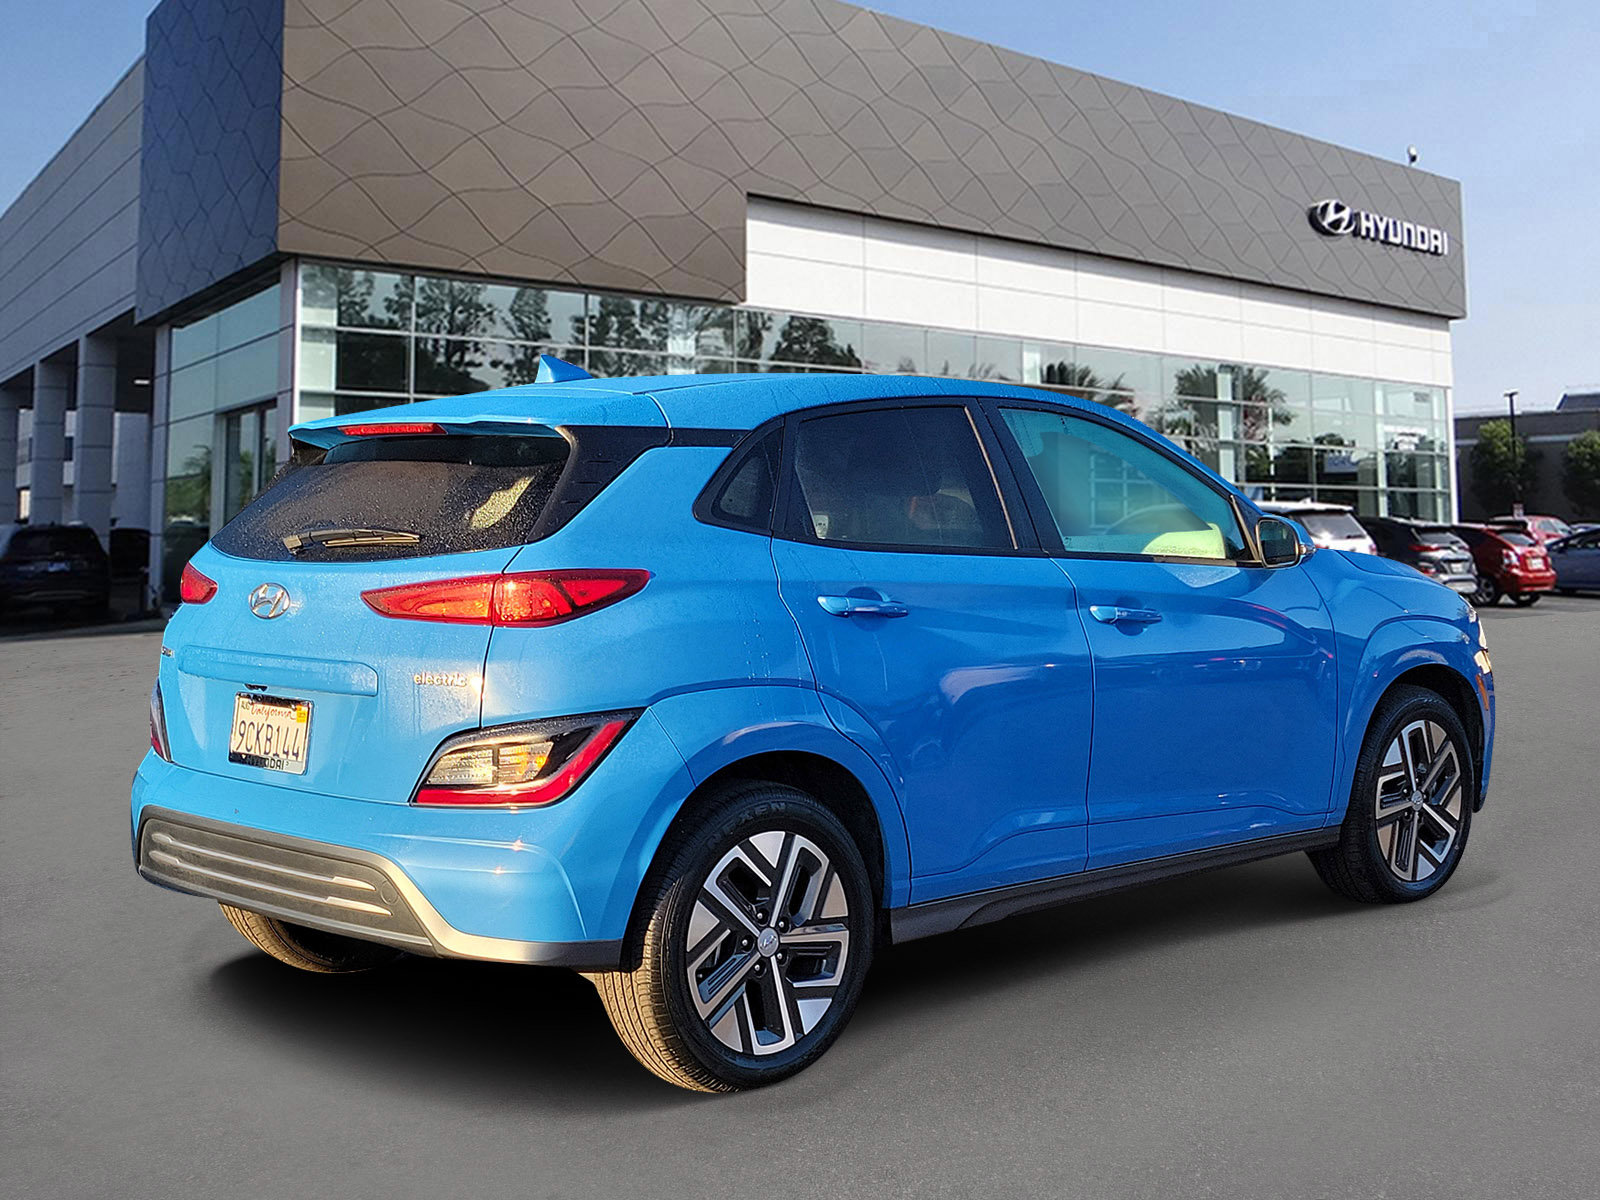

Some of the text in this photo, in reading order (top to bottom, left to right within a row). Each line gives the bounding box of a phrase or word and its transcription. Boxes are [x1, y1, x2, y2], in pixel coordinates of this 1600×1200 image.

[1360, 211, 1448, 255] HYUNDAI
[413, 672, 467, 687] electric
[236, 720, 299, 761] 9CKB144
